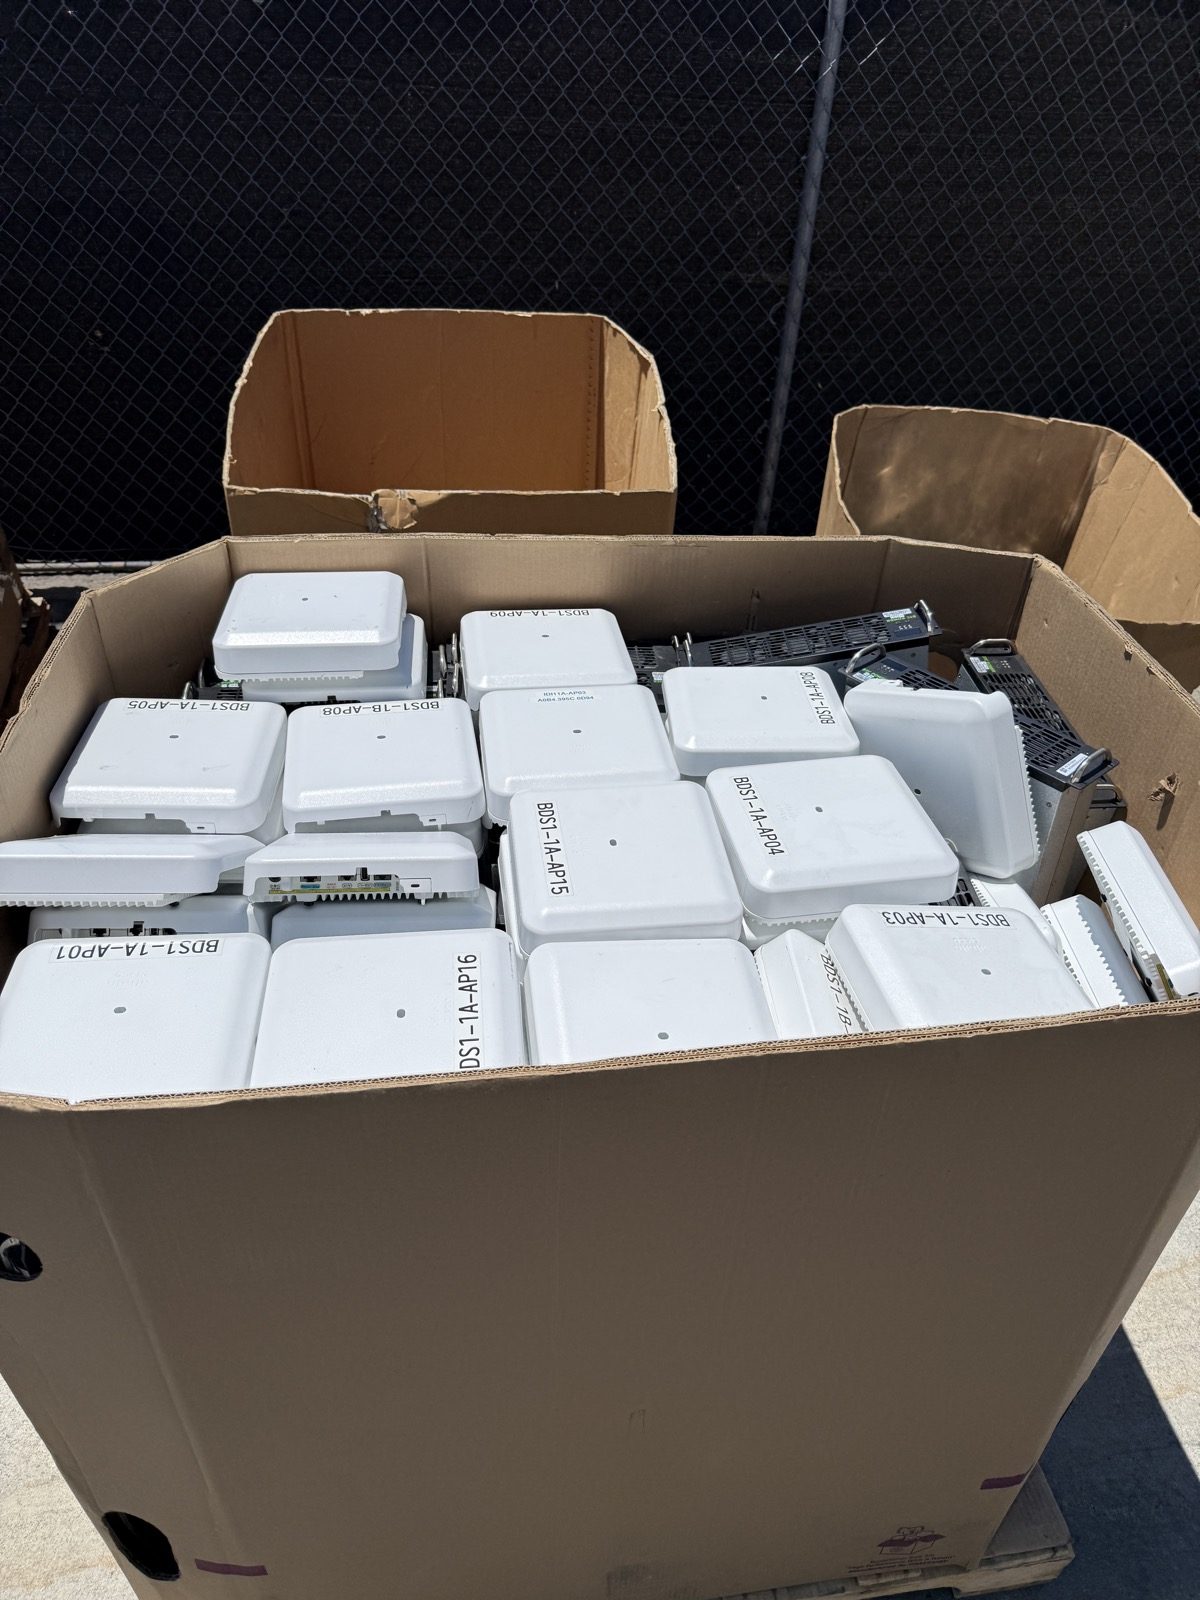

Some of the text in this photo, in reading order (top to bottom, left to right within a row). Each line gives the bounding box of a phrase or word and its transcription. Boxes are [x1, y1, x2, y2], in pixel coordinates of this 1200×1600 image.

[489, 609, 590, 618] BDS1-1A-AP09
[127, 700, 250, 711] BDS1-1A-AP05
[322, 701, 440, 716] BDS1-1B-AP08
[800, 671, 836, 725] BDS1-1A-AP08
[733, 776, 785, 856] BDS1-1A-AP04
[537, 802, 570, 895] BDS1-1A-AP15
[881, 911, 1011, 927] BDS1-1A-AP03
[56, 939, 220, 960] BDS1-1A-AP01
[457, 954, 480, 1069] DS1-1A-AP16
[820, 953, 852, 1034] BDS1-1B-
